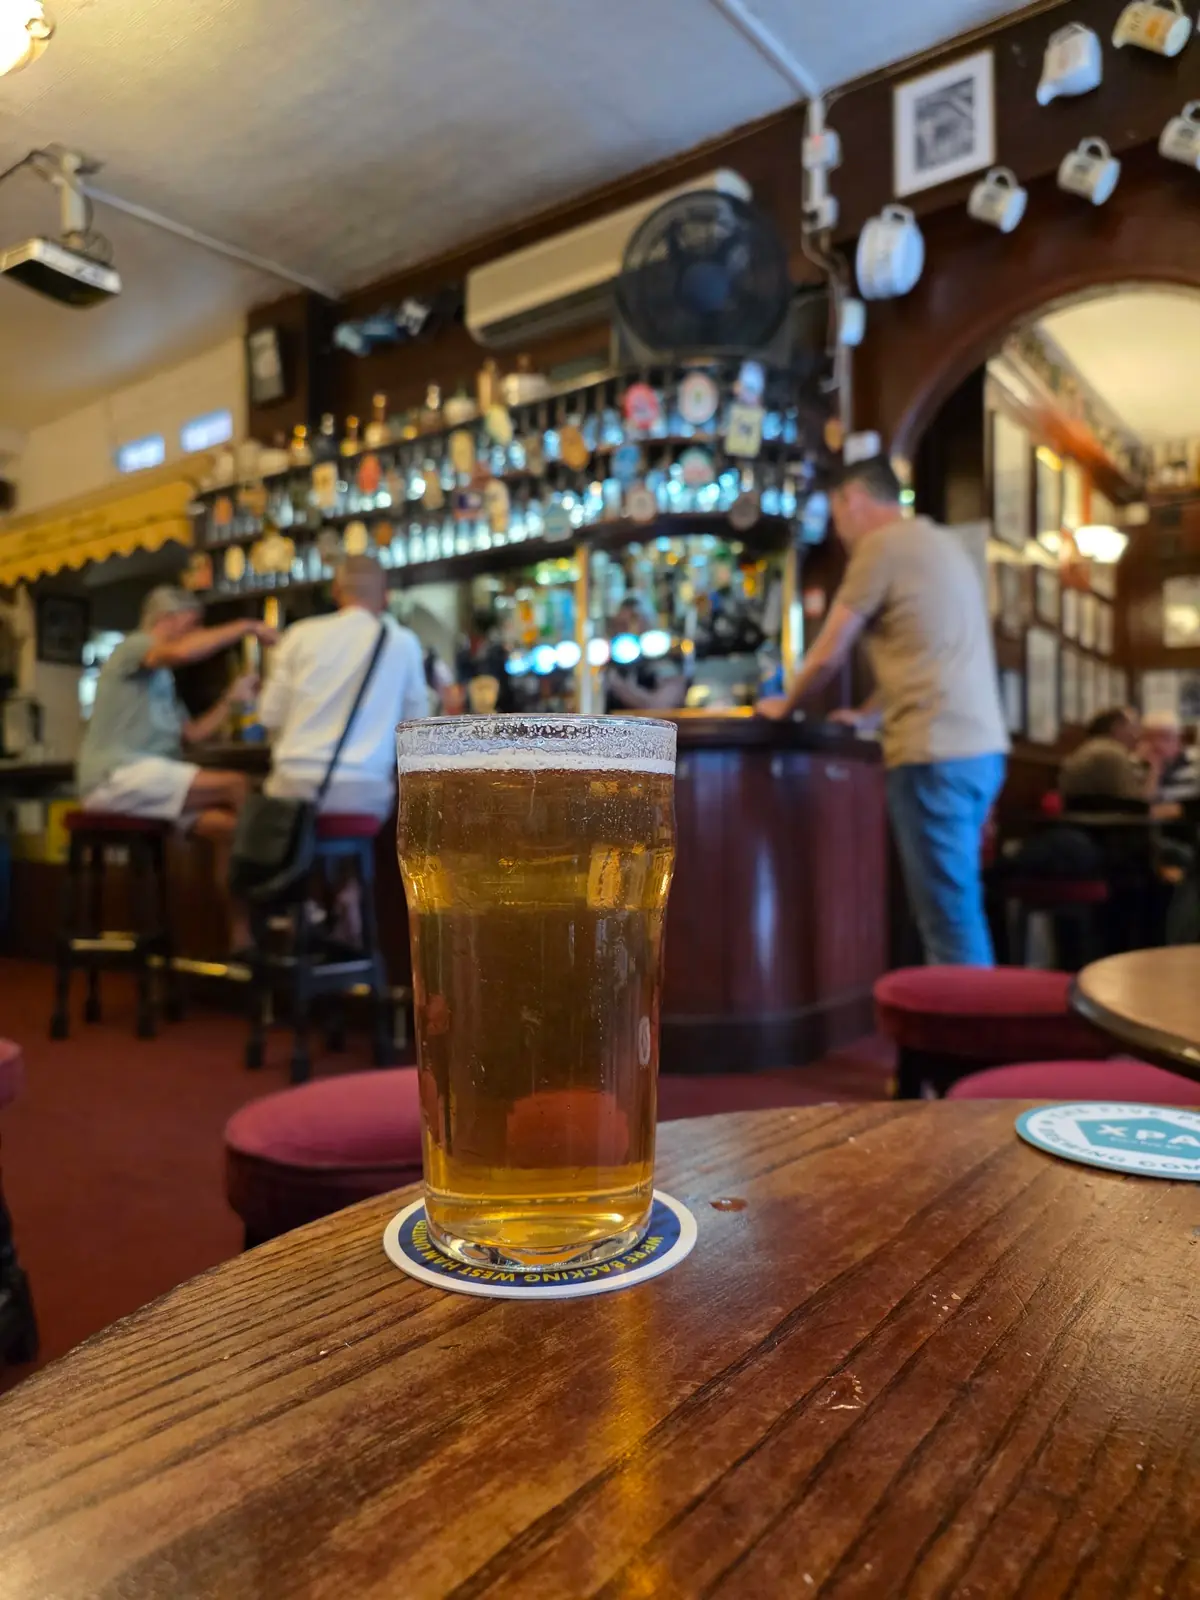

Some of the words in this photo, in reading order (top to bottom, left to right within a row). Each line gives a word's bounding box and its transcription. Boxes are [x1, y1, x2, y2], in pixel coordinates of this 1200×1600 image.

[1096, 1123, 1200, 1147] XPA
[421, 1250, 460, 1271] HAM
[622, 1236, 664, 1263] WE'RE
[457, 1266, 516, 1282] WEST
[523, 1260, 626, 1282] BACKING
